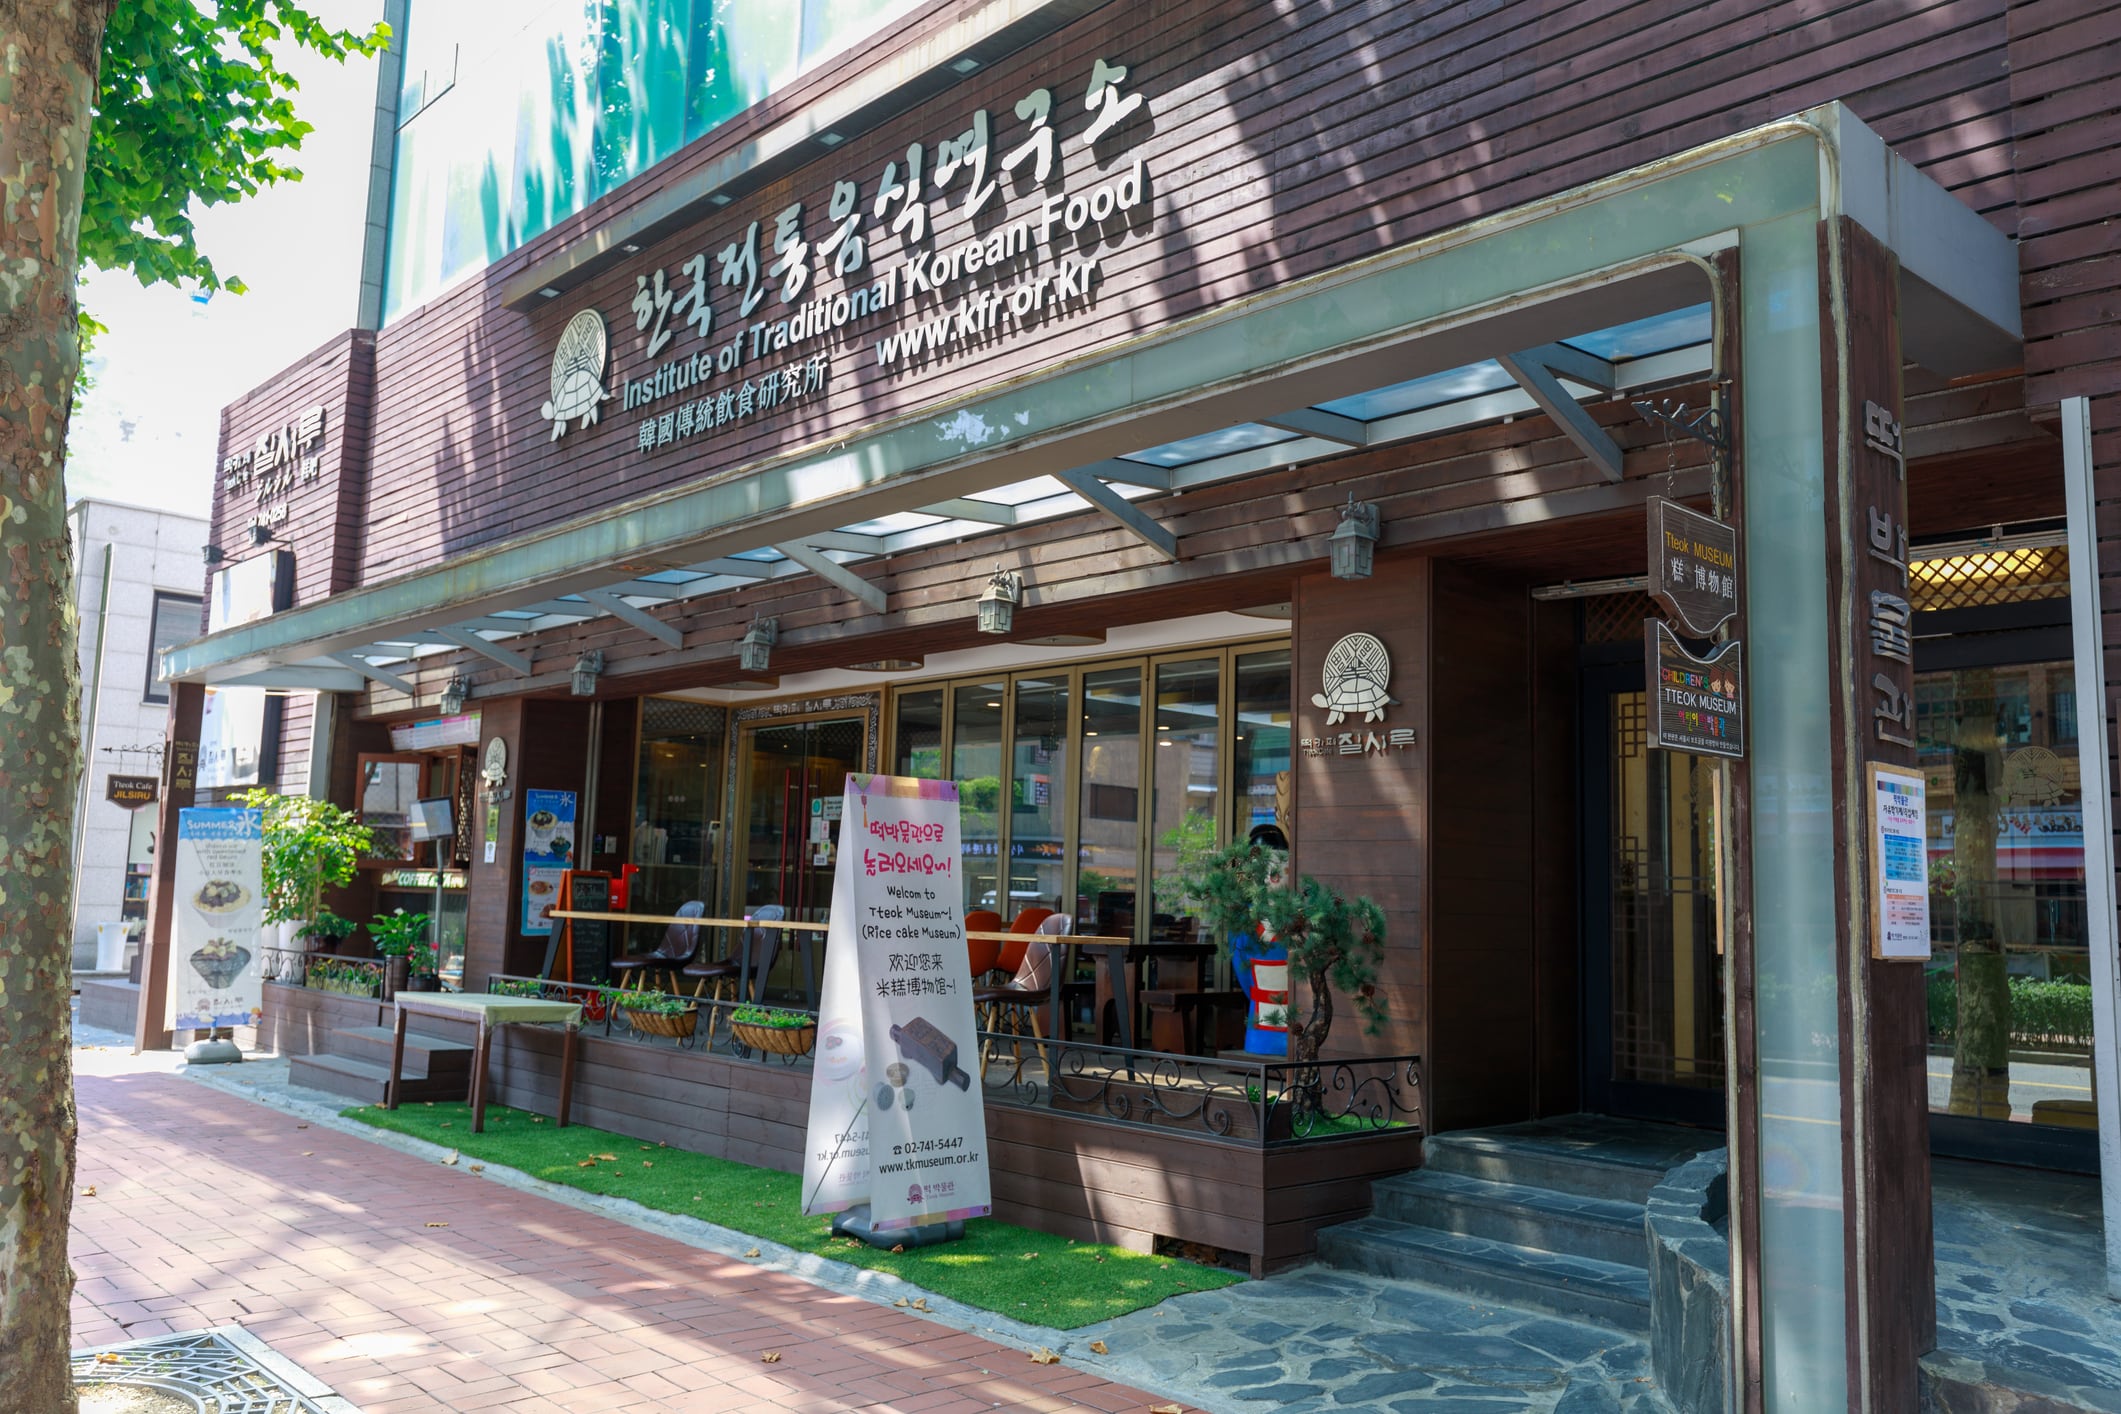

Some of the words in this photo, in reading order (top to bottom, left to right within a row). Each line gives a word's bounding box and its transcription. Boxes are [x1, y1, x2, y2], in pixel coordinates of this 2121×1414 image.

[623, 352, 712, 411] Institute
[718, 335, 744, 373] of
[749, 278, 895, 359] Traditional
[907, 226, 1027, 296] Korean
[1040, 160, 1142, 246] Food
[876, 257, 1096, 366] www.kfr.or.kr
[253, 405, 323, 476] 질시루
[1665, 531, 1689, 553] Tteok
[1694, 541, 1733, 569] MUSEUM
[1661, 666, 1709, 689] CHILDREN'S
[1665, 688, 1697, 707] TTEOK
[1700, 695, 1737, 715] MUSEUM
[1338, 728, 1415, 755] 질시루
[114, 791, 151, 800] JILSIRU
[870, 820, 945, 843] 떡박물관으로
[886, 885, 922, 899] Welcom
[924, 888, 936, 899] to
[869, 906, 903, 919] Tteok
[861, 925, 892, 940] (Rice
[896, 925, 919, 939] cake
[922, 927, 961, 940] Museum)
[888, 953, 944, 972] 欢迎您来
[905, 1136, 964, 1154] 02-741-5447
[879, 1151, 979, 1175] www.tkmuseum.or.kr
